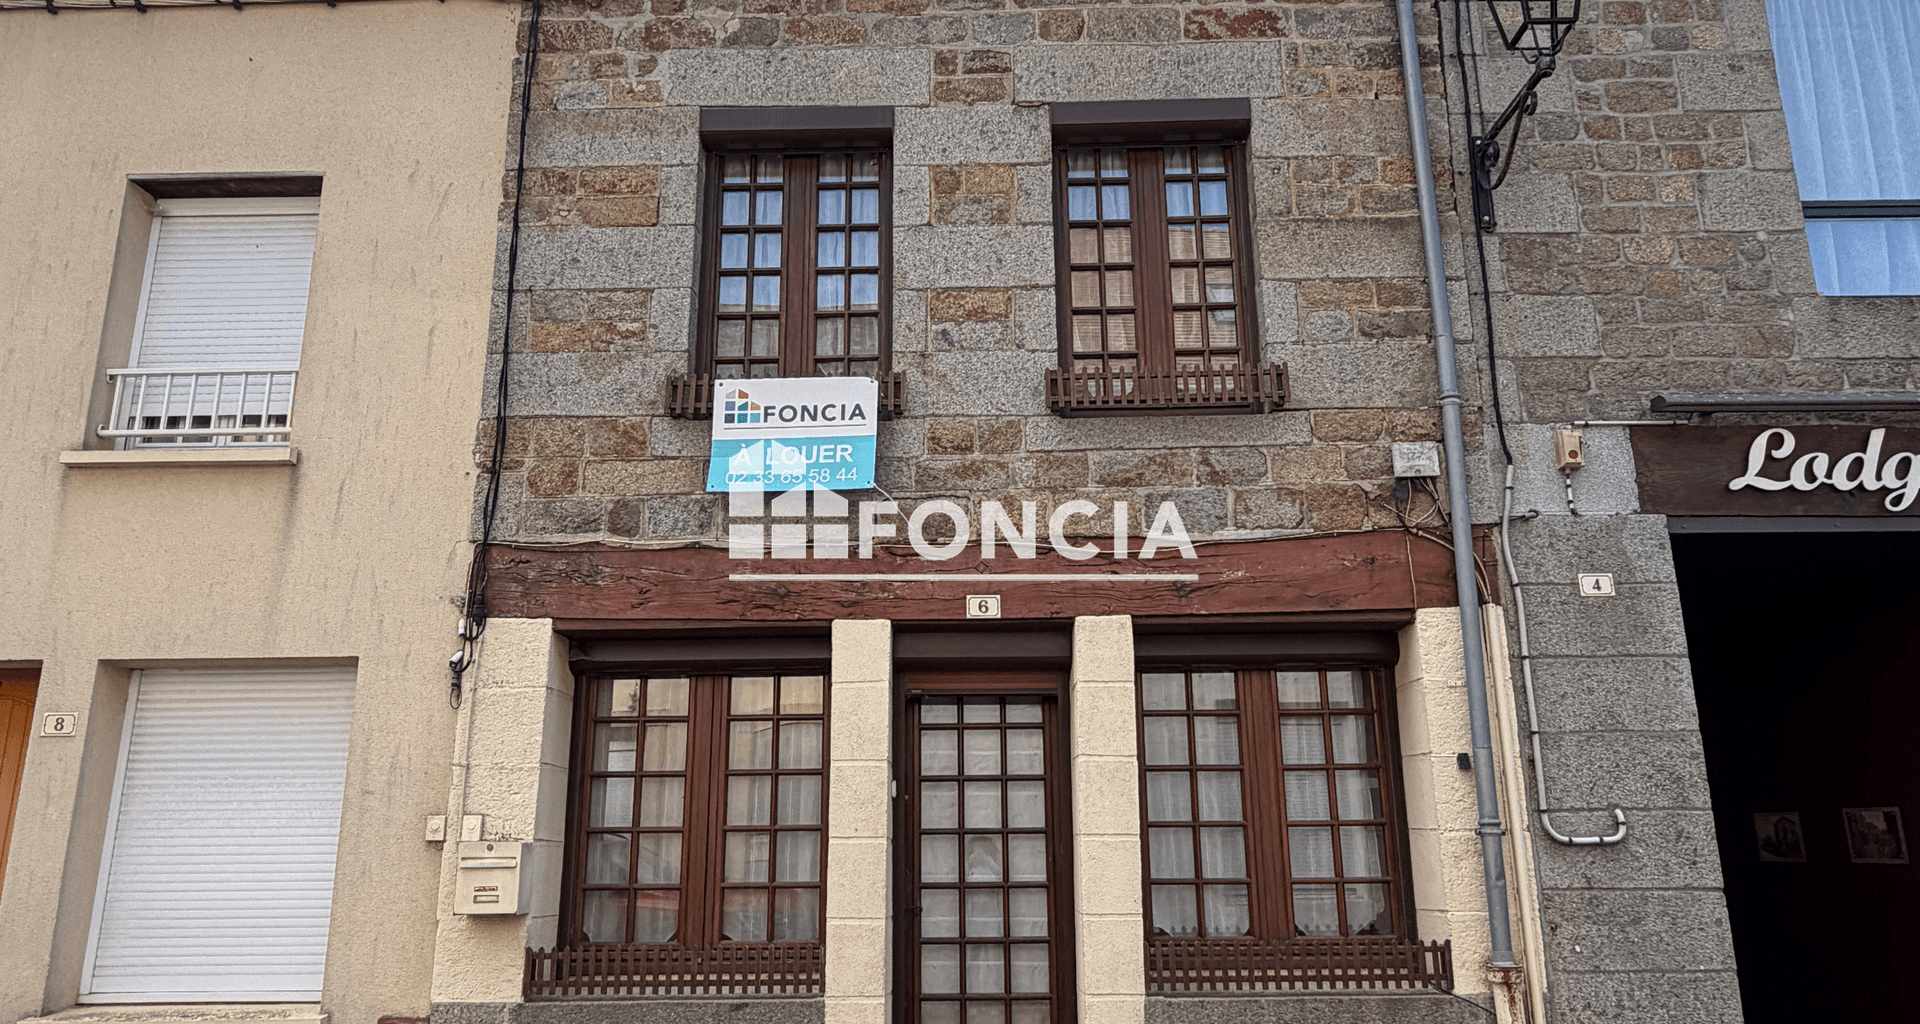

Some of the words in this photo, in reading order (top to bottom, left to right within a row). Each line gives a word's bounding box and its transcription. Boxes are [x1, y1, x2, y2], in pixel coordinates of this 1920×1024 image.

[763, 403, 867, 423] FONCIA
[732, 443, 752, 467] À
[765, 444, 854, 466] LOUER
[725, 470, 747, 484] 02
[752, 470, 775, 484] 33
[780, 469, 803, 484] 65
[808, 468, 830, 483] 58
[835, 467, 858, 482] 44
[1592, 578, 1602, 591] 4
[978, 600, 989, 613] 6
[54, 717, 64, 731] 8
